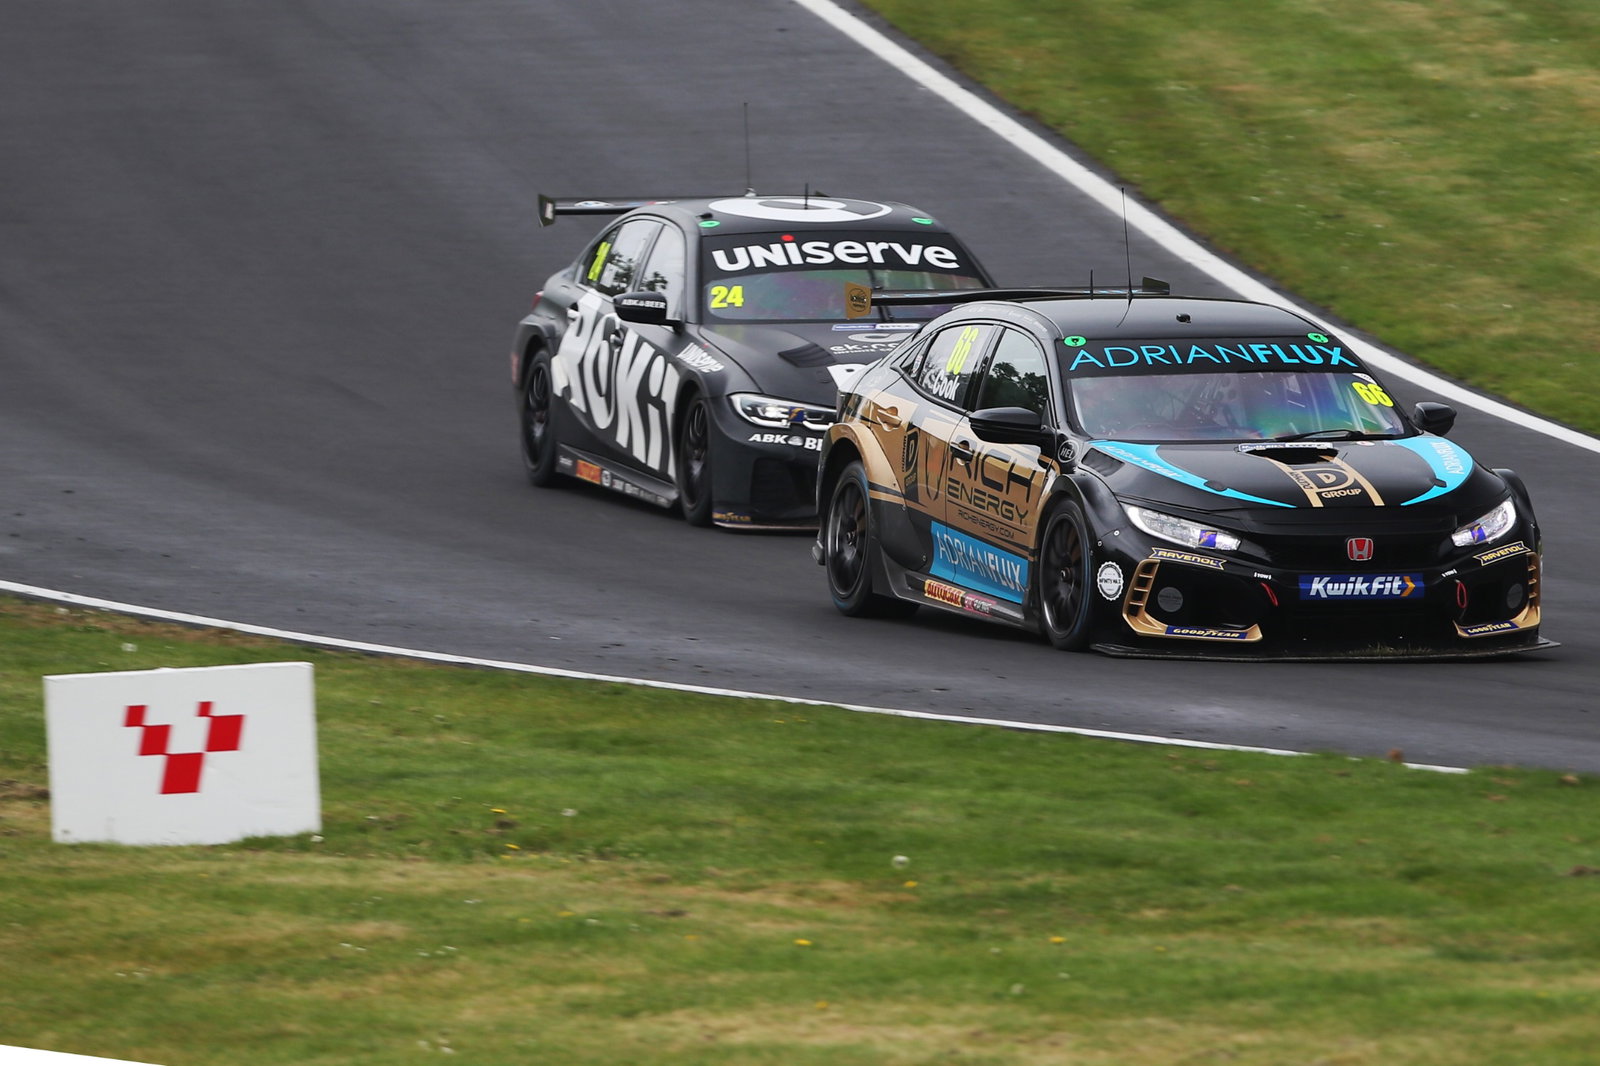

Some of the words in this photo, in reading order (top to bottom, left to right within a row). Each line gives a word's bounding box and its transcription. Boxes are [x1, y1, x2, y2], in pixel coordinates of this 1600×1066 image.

[710, 285, 744, 309] 24
[946, 325, 979, 375] 66
[932, 369, 960, 401] Cook
[1351, 382, 1394, 407] 66
[1060, 447, 1074, 459] HEL
[949, 443, 1037, 503] RICH
[947, 477, 1029, 525] ENERGY
[1321, 488, 1362, 499] GROUP
[1157, 550, 1219, 566] RAVENOL
[1481, 544, 1524, 562] RAVENOL
[1173, 628, 1240, 637] GOODYEAR
